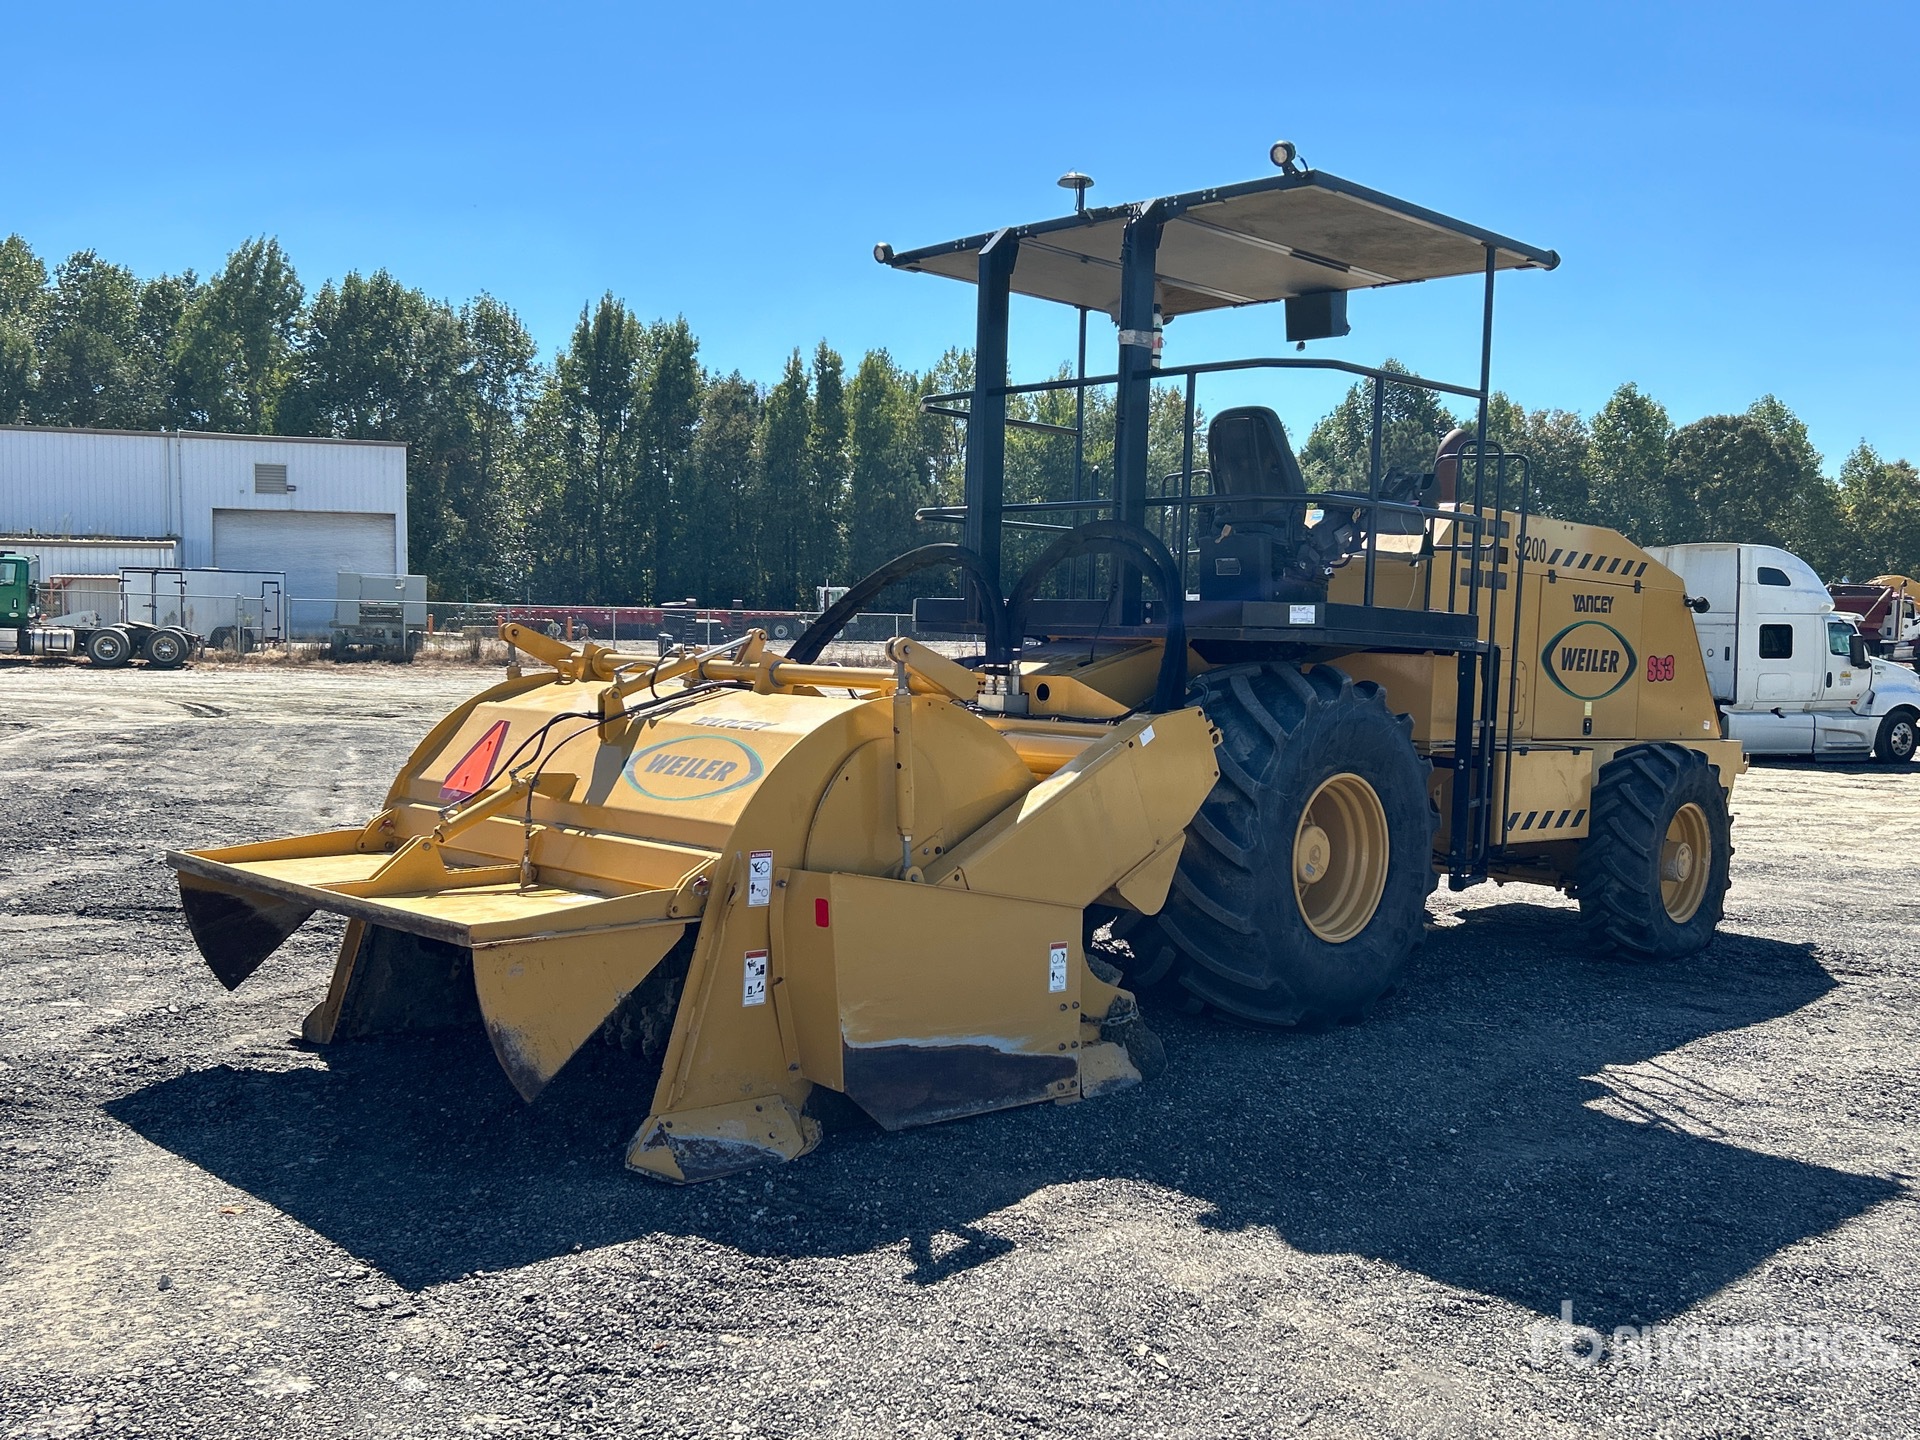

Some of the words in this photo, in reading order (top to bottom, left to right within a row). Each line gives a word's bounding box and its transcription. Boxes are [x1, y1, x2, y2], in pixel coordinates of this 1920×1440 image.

[1573, 594, 1614, 614] YANCEY
[1561, 647, 1620, 673] WEILER
[644, 753, 738, 782] WEILER
